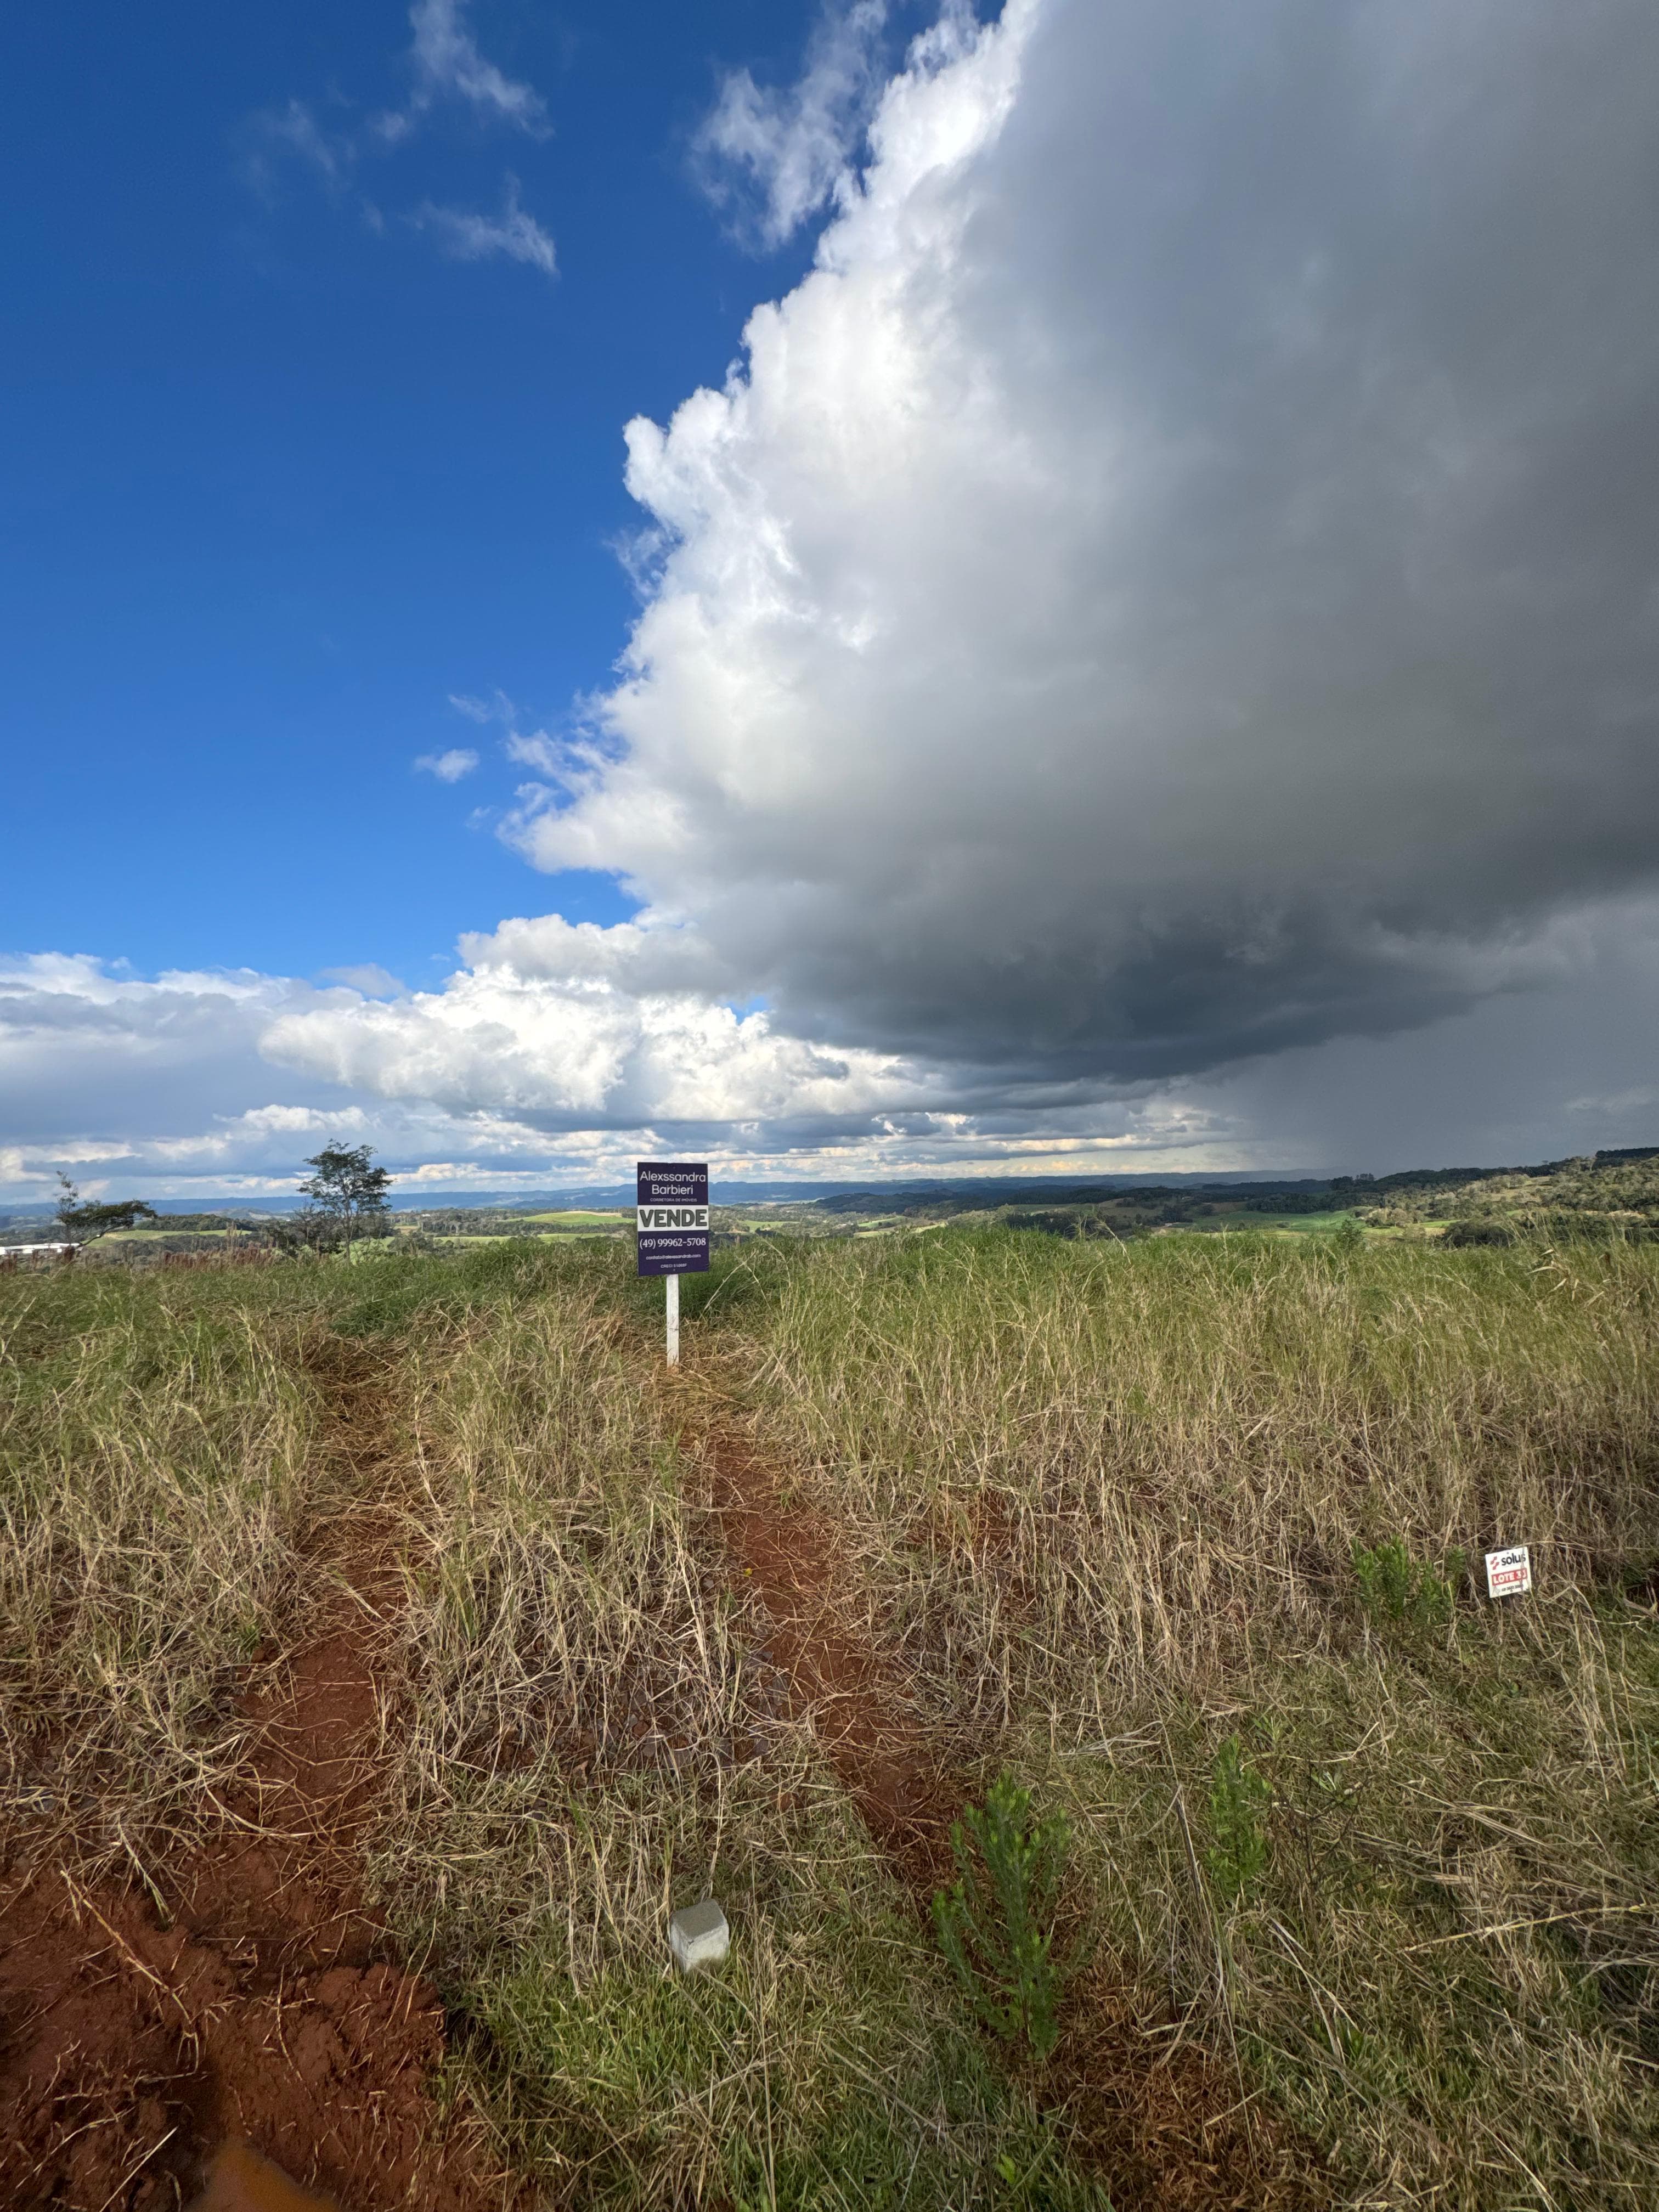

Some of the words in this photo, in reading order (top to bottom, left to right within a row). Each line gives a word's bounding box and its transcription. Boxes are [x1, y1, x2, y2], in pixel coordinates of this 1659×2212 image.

[640, 1171, 706, 1182] Alexssandra
[652, 1184, 693, 1195] Barbieri
[639, 1209, 707, 1227] VENDE
[640, 1238, 656, 1249] (49)
[657, 1238, 707, 1247] 99962-5708
[1501, 1553, 1526, 1566] solus
[1493, 1572, 1514, 1584] LOTE
